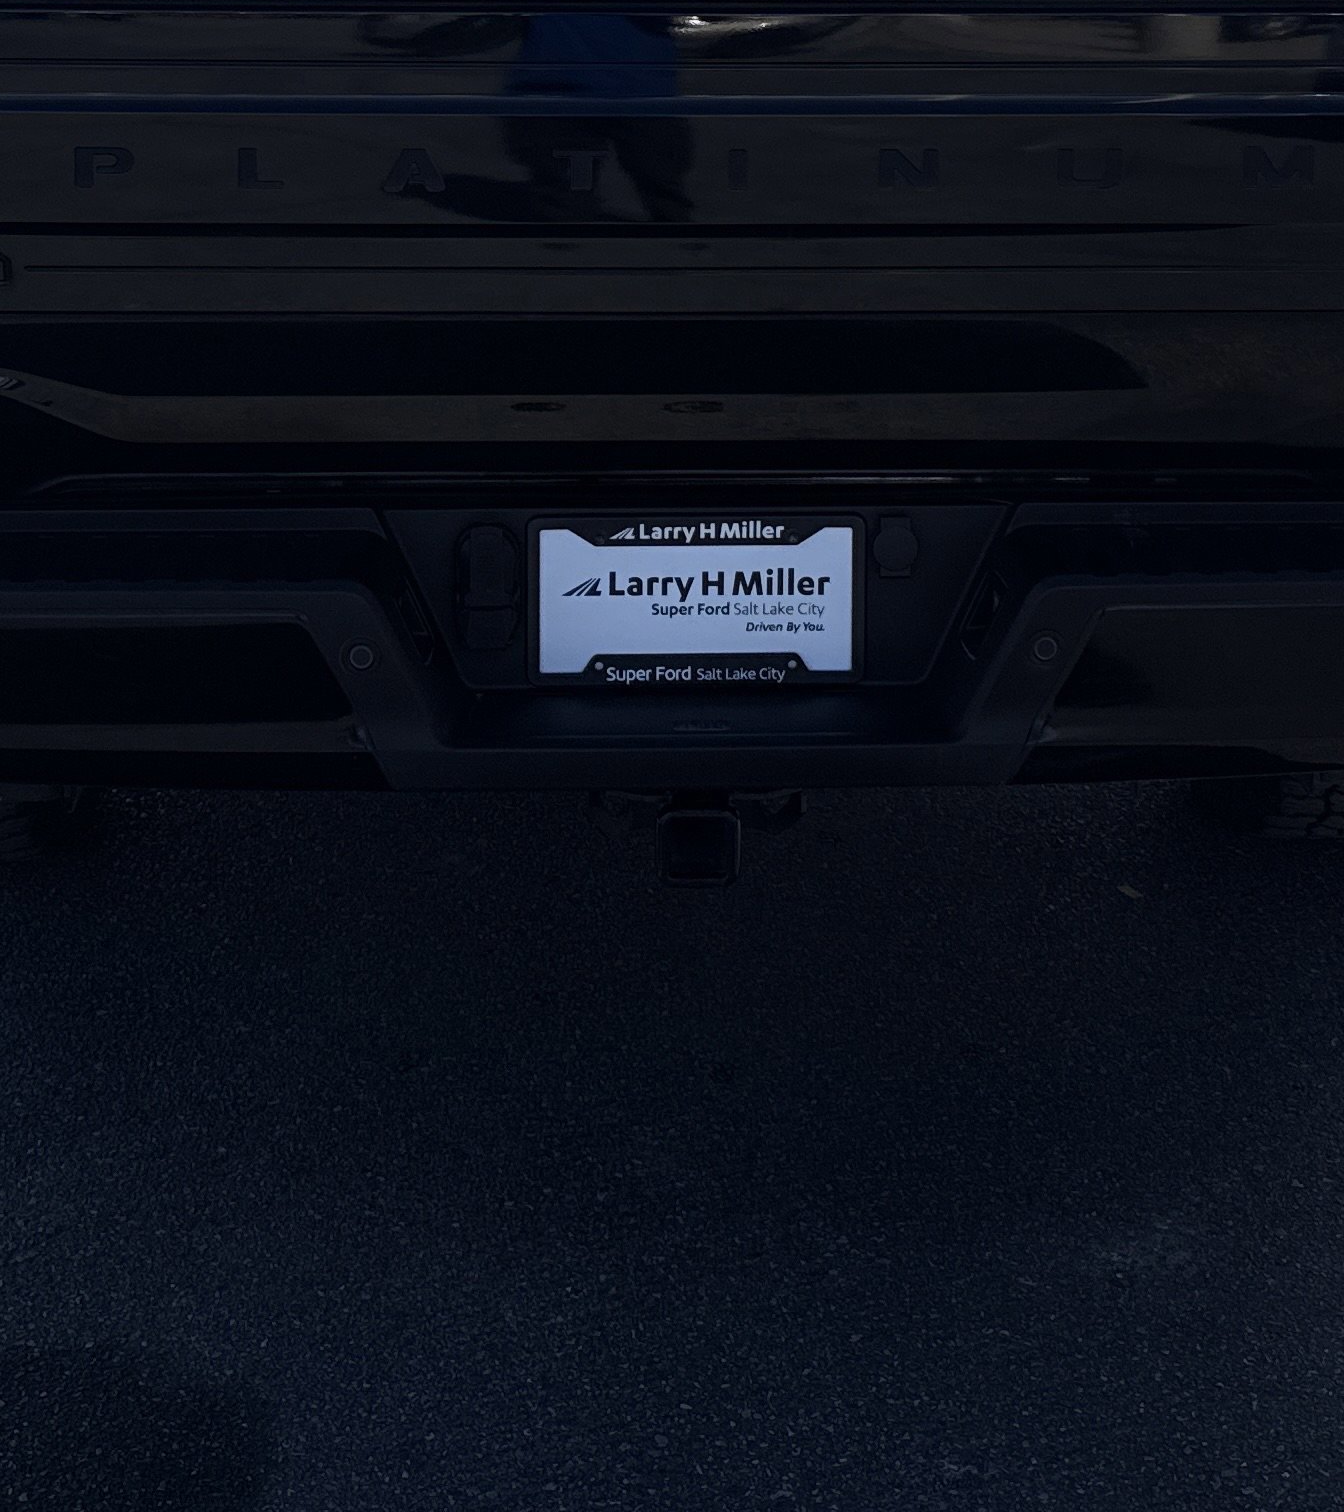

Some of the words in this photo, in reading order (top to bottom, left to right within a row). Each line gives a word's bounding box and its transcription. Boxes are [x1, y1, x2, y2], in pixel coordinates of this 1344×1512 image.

[73, 146, 1316, 194] PLATINUM
[639, 523, 696, 544] Larry
[699, 522, 716, 539] H
[719, 520, 785, 539] Miller
[609, 571, 695, 602] Larry
[701, 571, 725, 596] H
[732, 568, 831, 596] Miller
[651, 603, 694, 618] Super
[697, 602, 730, 616] Ford
[733, 602, 760, 616] Salt
[762, 602, 794, 616] Lake
[797, 601, 826, 618] City
[745, 622, 783, 632] Driven
[786, 622, 801, 634] By
[606, 666, 653, 685] Super
[656, 666, 692, 681] Ford
[696, 667, 723, 681] Salt
[726, 667, 757, 680] Lake
[759, 666, 786, 684] City
